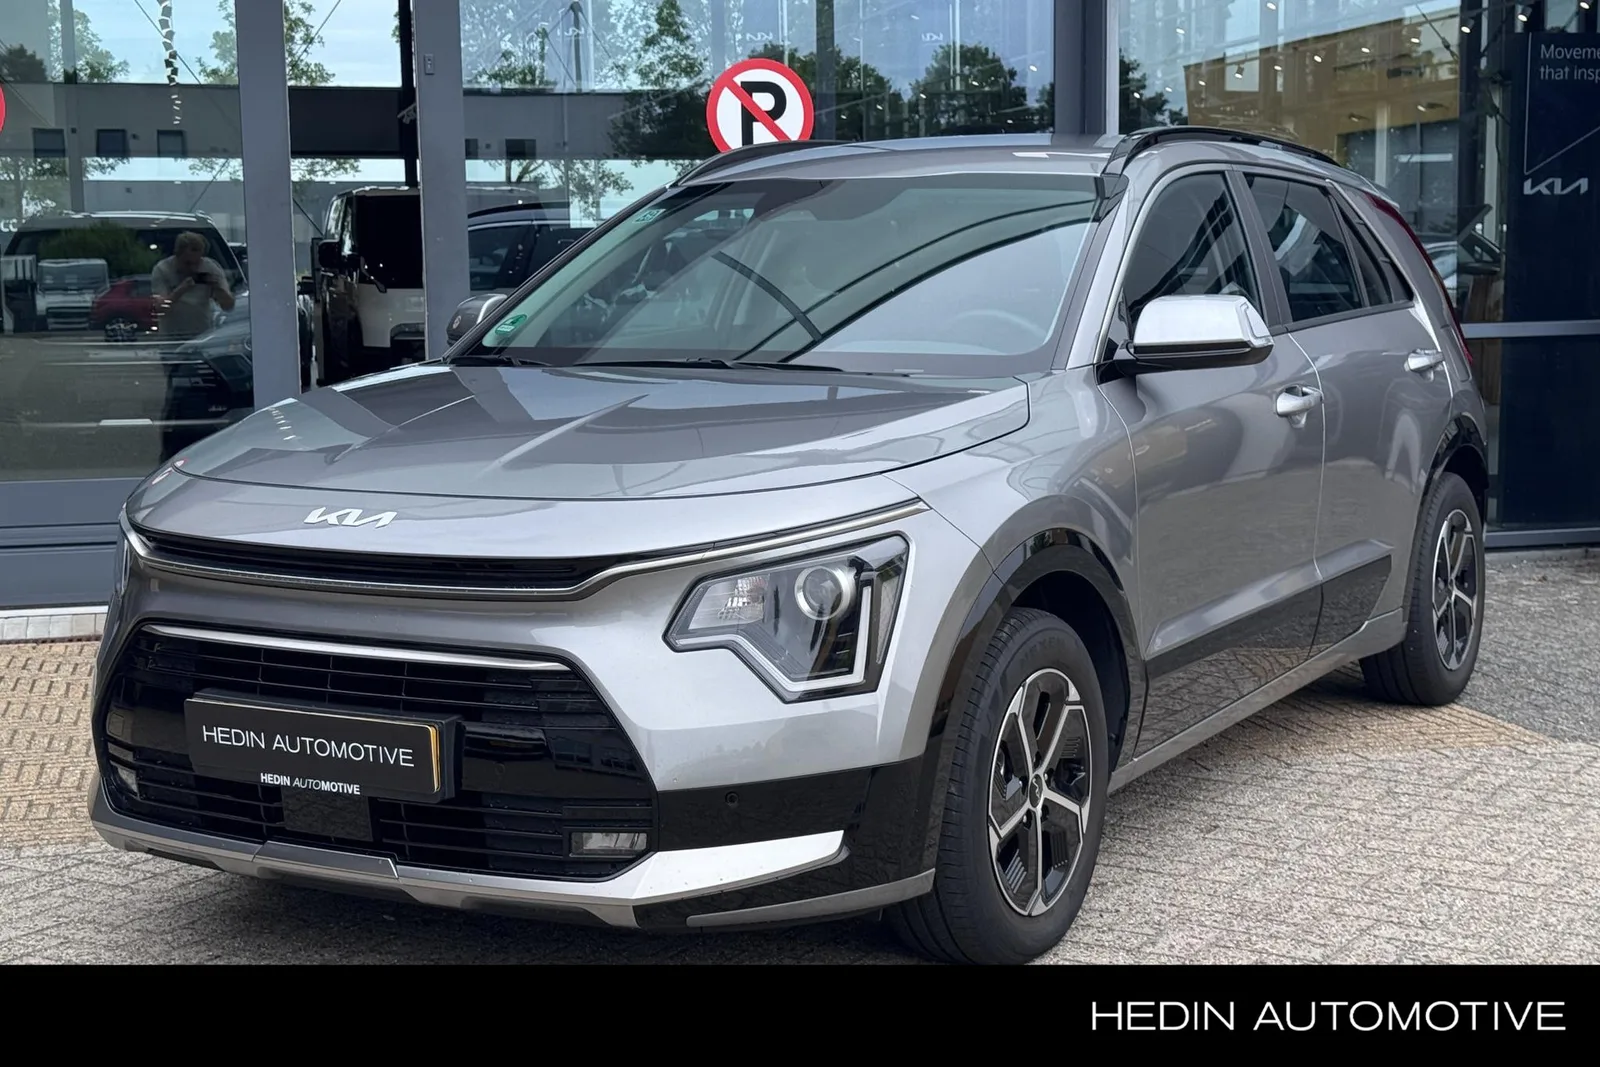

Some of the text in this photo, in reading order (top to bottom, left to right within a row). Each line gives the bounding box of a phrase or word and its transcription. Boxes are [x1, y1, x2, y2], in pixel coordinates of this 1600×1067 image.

[1540, 65, 1569, 80] that
[740, 81, 787, 147] P
[1523, 177, 1589, 195] KIA
[303, 506, 398, 529] KIA
[202, 725, 415, 767] HEDIN AUTOMOTIVE
[260, 773, 361, 795] HEDIN AUTOMOTIVE
